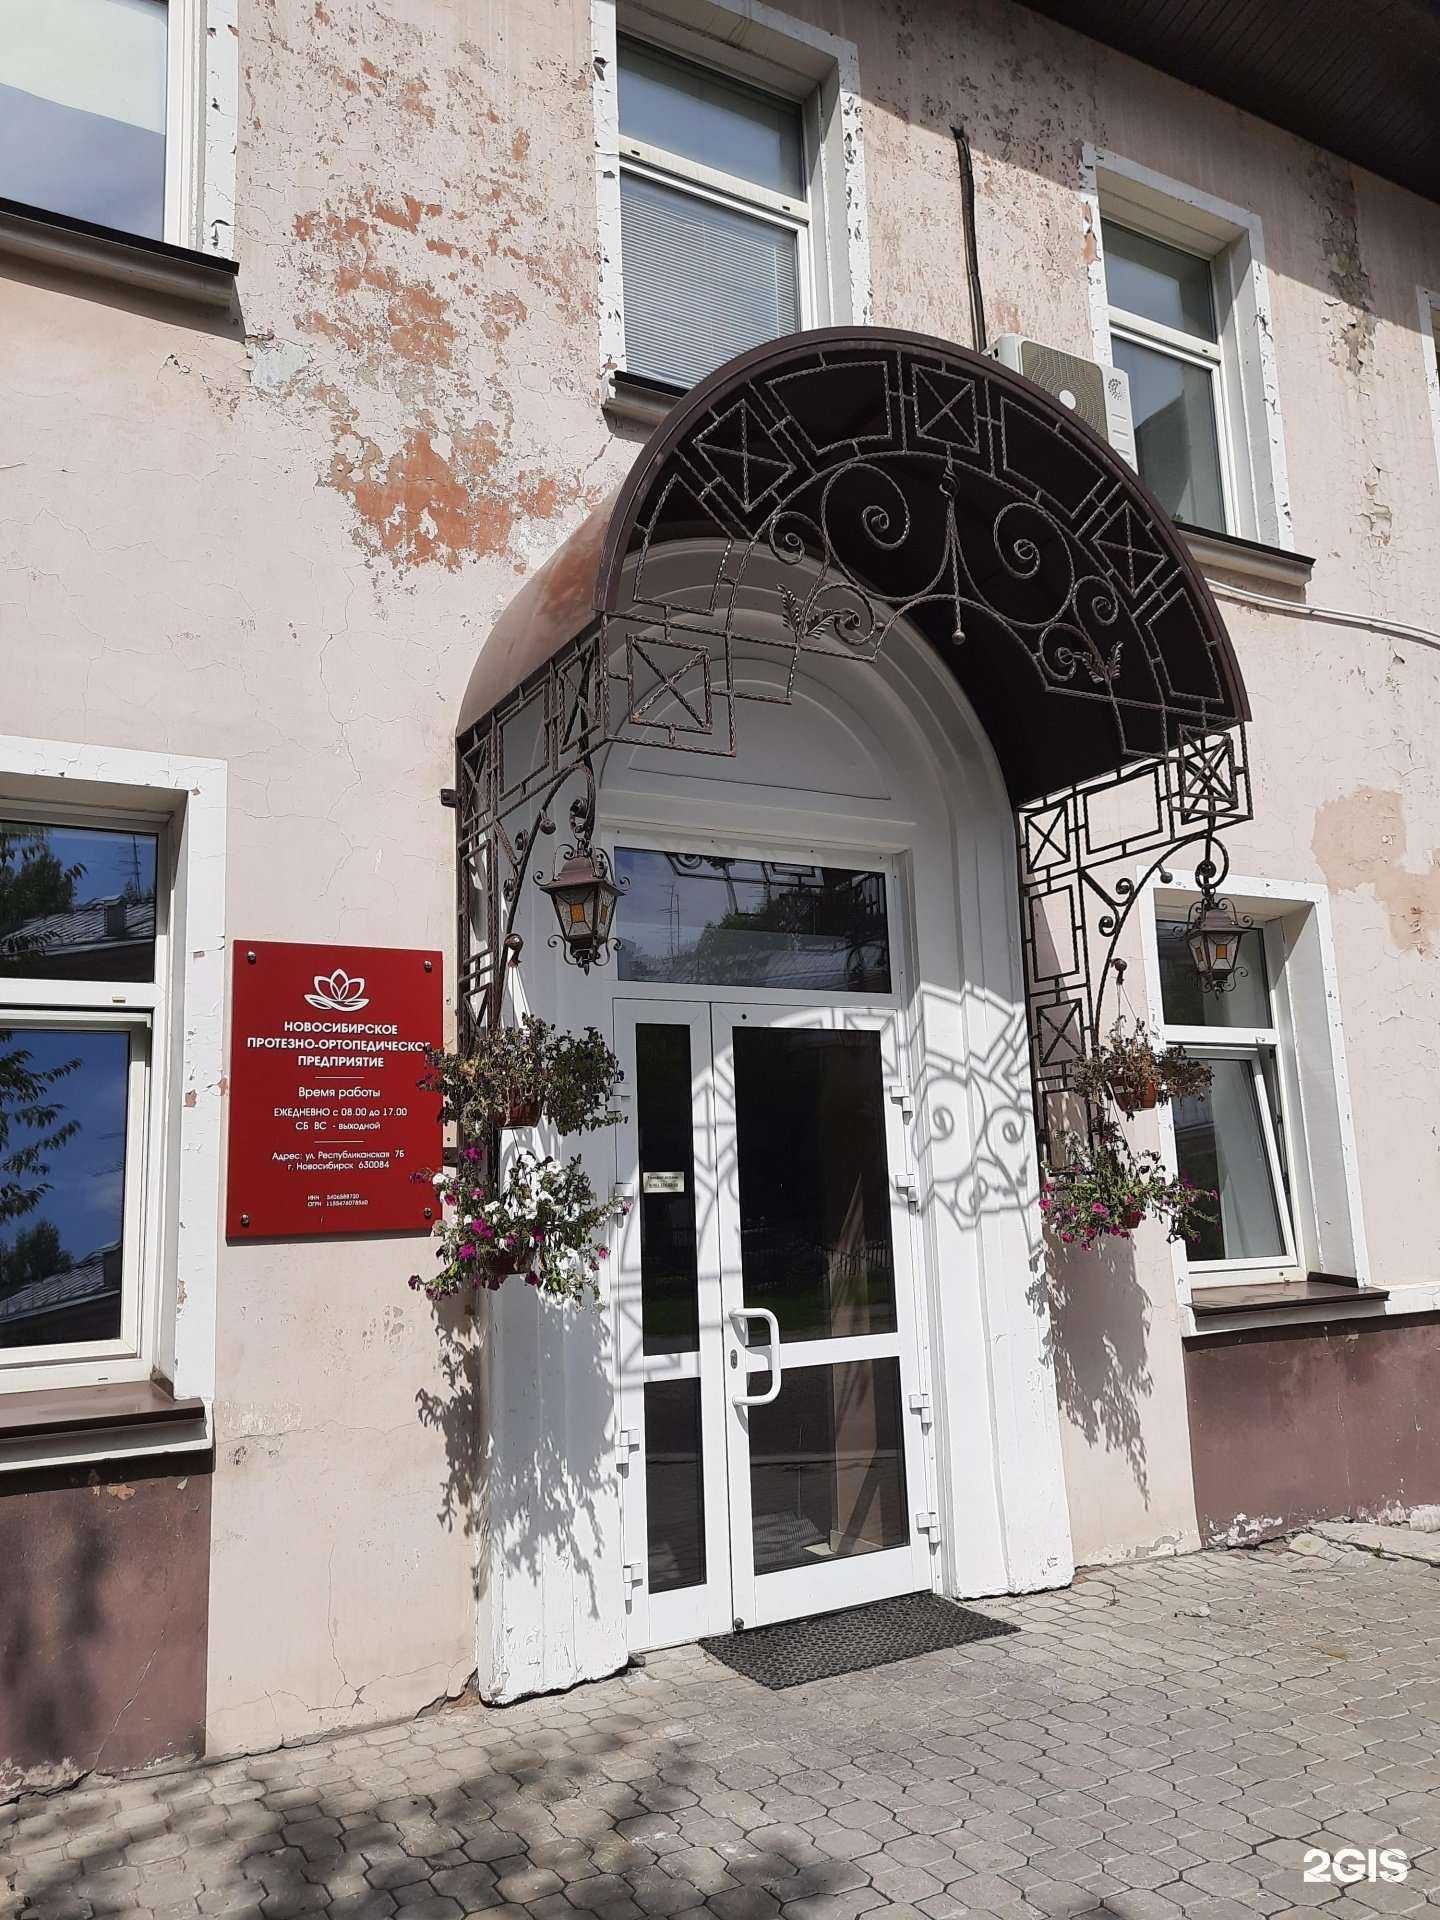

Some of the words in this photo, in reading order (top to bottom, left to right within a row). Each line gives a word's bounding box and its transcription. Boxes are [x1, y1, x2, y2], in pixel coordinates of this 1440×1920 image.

[284, 1021, 398, 1035] НОВОСИБИРСКОЕ
[297, 1055, 384, 1068] ПРЕДПРИЯТИЕ
[298, 1086, 335, 1100] Время
[338, 1087, 381, 1100] работы
[274, 1107, 330, 1118] ЕЖЕДНЕВНО
[368, 1109, 380, 1117] до
[383, 1107, 408, 1116] 17.00
[295, 1121, 309, 1130] СБ
[314, 1121, 327, 1130] ВС
[338, 1121, 381, 1131] выходной
[271, 1151, 303, 1161] Адрес:
[305, 1152, 315, 1162] ул.
[318, 1150, 390, 1161] Республиканская
[296, 1161, 354, 1171] Новосибирск
[358, 1160, 390, 1169] 630084
